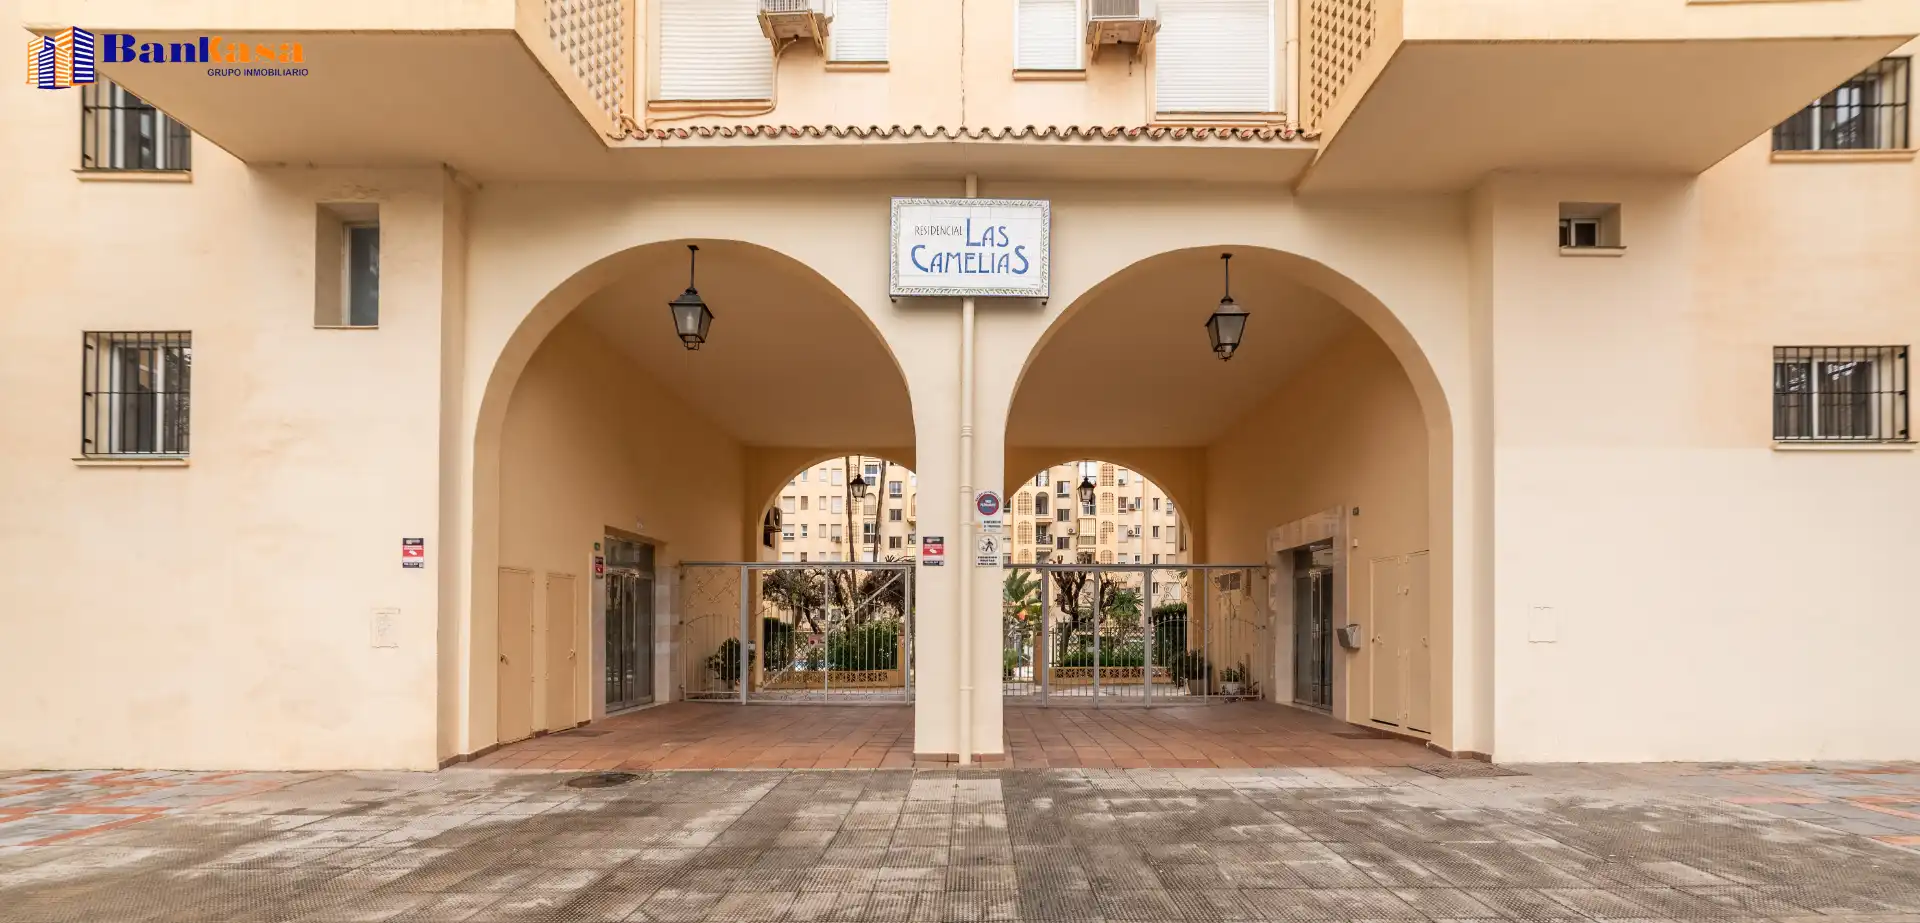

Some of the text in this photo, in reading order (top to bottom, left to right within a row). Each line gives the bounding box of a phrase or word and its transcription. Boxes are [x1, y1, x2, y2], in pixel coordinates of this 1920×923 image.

[914, 225, 963, 236] RESIDENCIAL
[965, 218, 1009, 248] LAS
[911, 244, 1029, 275] CAMELIAS
